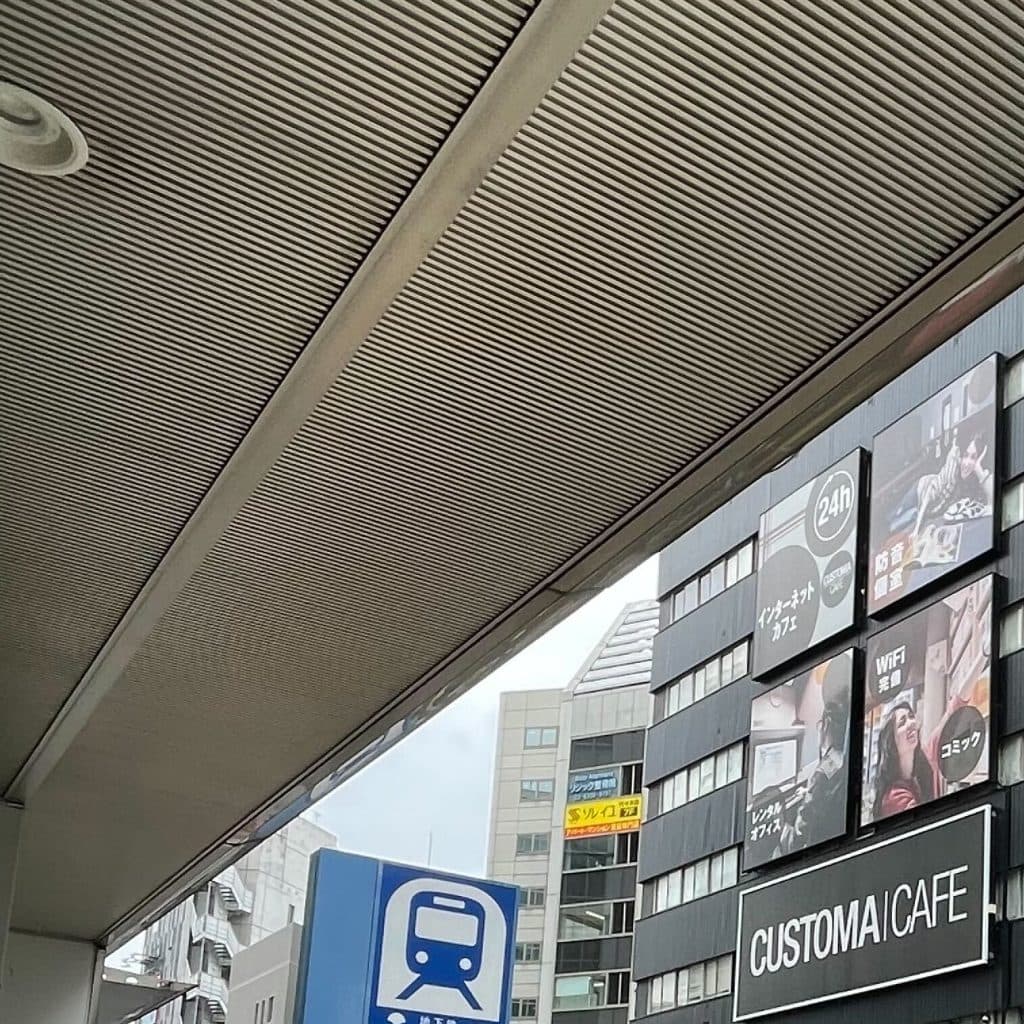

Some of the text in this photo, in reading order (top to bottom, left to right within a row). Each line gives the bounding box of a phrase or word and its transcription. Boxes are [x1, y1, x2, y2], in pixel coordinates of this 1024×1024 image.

[818, 484, 851, 527] 24h
[758, 581, 815, 627] インターネット
[771, 615, 798, 642] カフェ
[941, 730, 981, 759] コミック
[751, 801, 781, 824] レンタル
[750, 817, 782, 841] オフィス
[750, 864, 969, 977] CUSTOMA CAFE
